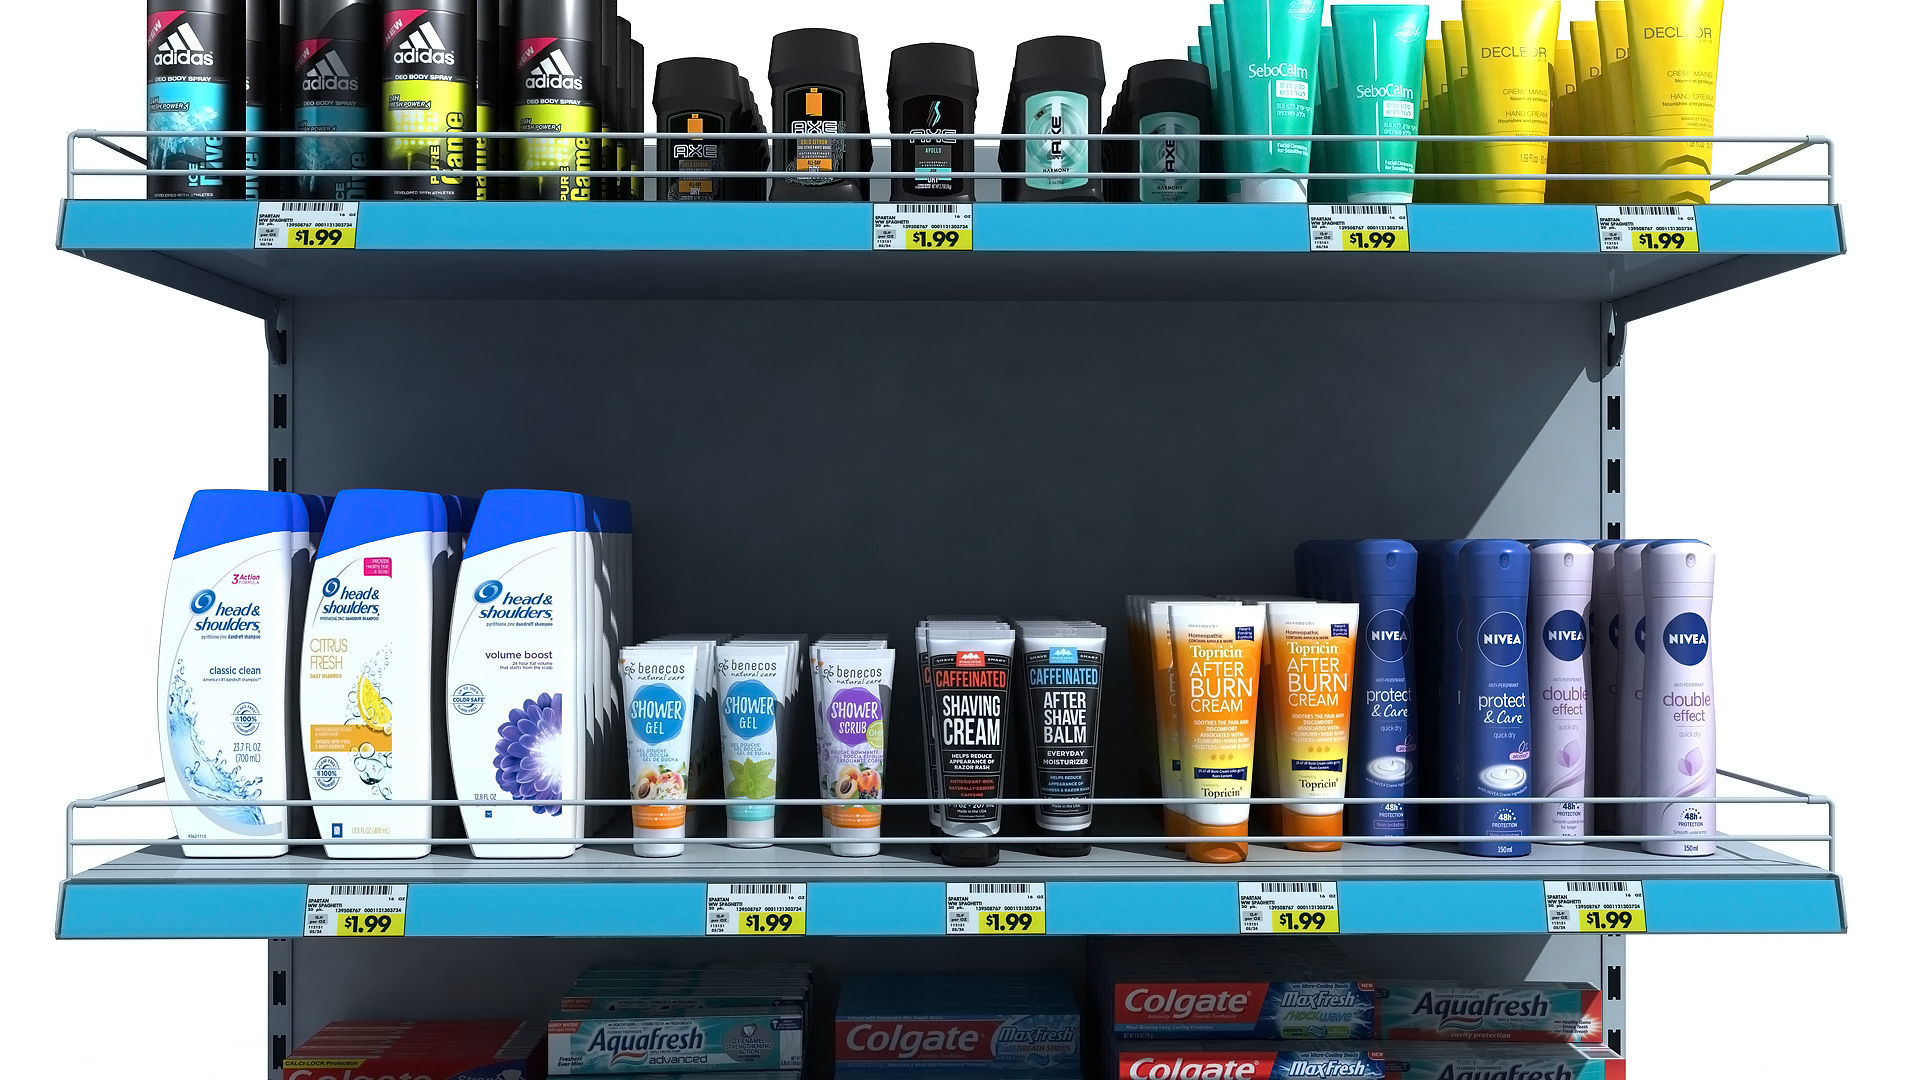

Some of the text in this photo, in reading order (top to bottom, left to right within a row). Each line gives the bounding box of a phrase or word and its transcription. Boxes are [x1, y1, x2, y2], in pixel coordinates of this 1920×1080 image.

[385, 19, 402, 44] NEW
[154, 50, 214, 66] adidas
[394, 48, 455, 65] adidas
[1249, 63, 1308, 79] SeboCalm
[302, 76, 358, 90] adidas
[526, 74, 583, 90] adidas
[1357, 84, 1413, 99] SeboCalm
[792, 121, 837, 134] AXE
[910, 129, 956, 143] AXE
[674, 144, 718, 158] AXE
[1166, 140, 1176, 172] AXE
[295, 229, 342, 246] $1.99
[913, 231, 959, 247] $1.99
[1350, 232, 1395, 248] $1.99
[1639, 233, 1685, 249] $1.99
[322, 600, 379, 614] shoulders
[479, 606, 552, 619] shoulders
[194, 617, 260, 631] shoulders
[1372, 631, 1407, 640] NIVEA
[1484, 634, 1521, 644] NIVEA
[1549, 631, 1584, 640] NIVEA
[1669, 634, 1706, 644] NIVEA
[310, 638, 348, 652] CITRUS
[1190, 645, 1242, 660] Topricin
[1287, 642, 1338, 656] Topricin
[210, 666, 261, 674] classic clean
[310, 656, 342, 669] FRESH
[638, 662, 685, 674] benecos
[732, 660, 777, 670] benecos
[1190, 662, 1244, 676] AFTER
[1287, 658, 1339, 672] AFTER
[837, 665, 882, 678] benecos
[936, 670, 1006, 688] CAFFEINATED
[1030, 668, 1098, 685] CAFFEINATED
[1191, 678, 1252, 698] BURN
[1289, 673, 1347, 692] BURN
[1044, 692, 1086, 708] AFTER
[1288, 693, 1338, 706] CREAM
[1367, 688, 1412, 704] protect
[1543, 687, 1588, 700] double
[1663, 692, 1710, 707] double
[725, 696, 774, 715] SHOWER
[943, 695, 1000, 717] SHAVING
[1191, 699, 1242, 712] CREAM
[1479, 693, 1525, 711] protect
[1552, 704, 1583, 715] effect
[631, 700, 682, 720] SHOWER
[831, 702, 878, 719] SHOWER
[1044, 710, 1086, 725] SHAVE
[1372, 704, 1408, 717] & Care
[1484, 710, 1524, 724] & Care
[1673, 710, 1705, 721] effect
[646, 722, 664, 734] GEL
[740, 717, 757, 729] GEL
[839, 722, 866, 734] SCRUB
[943, 718, 1000, 745] CREAM
[1044, 726, 1086, 743] BALM
[233, 743, 261, 751] 23.7 FL OZ
[235, 754, 260, 763] (700 mL)
[1299, 779, 1336, 791] Topricin
[1201, 788, 1240, 798] Topricin
[345, 915, 391, 932] $1.99
[746, 914, 792, 931] $1.99
[986, 913, 1032, 931] $1.99
[1280, 912, 1325, 930] $1.99
[1586, 911, 1632, 929] $1.99
[1124, 988, 1248, 1019] Colgate
[1281, 991, 1355, 1009] MaxFresh
[1412, 991, 1548, 1019] Aquafresh
[587, 1027, 703, 1056] Aquafresh
[847, 1024, 979, 1058] Colgate
[998, 1027, 1075, 1044] MaxFresh
[649, 1054, 708, 1064] advanced
[1130, 1058, 1255, 1080] Colgate
[1289, 1060, 1365, 1079] MaxFresh
[1437, 1064, 1572, 1080] Aquafresh
